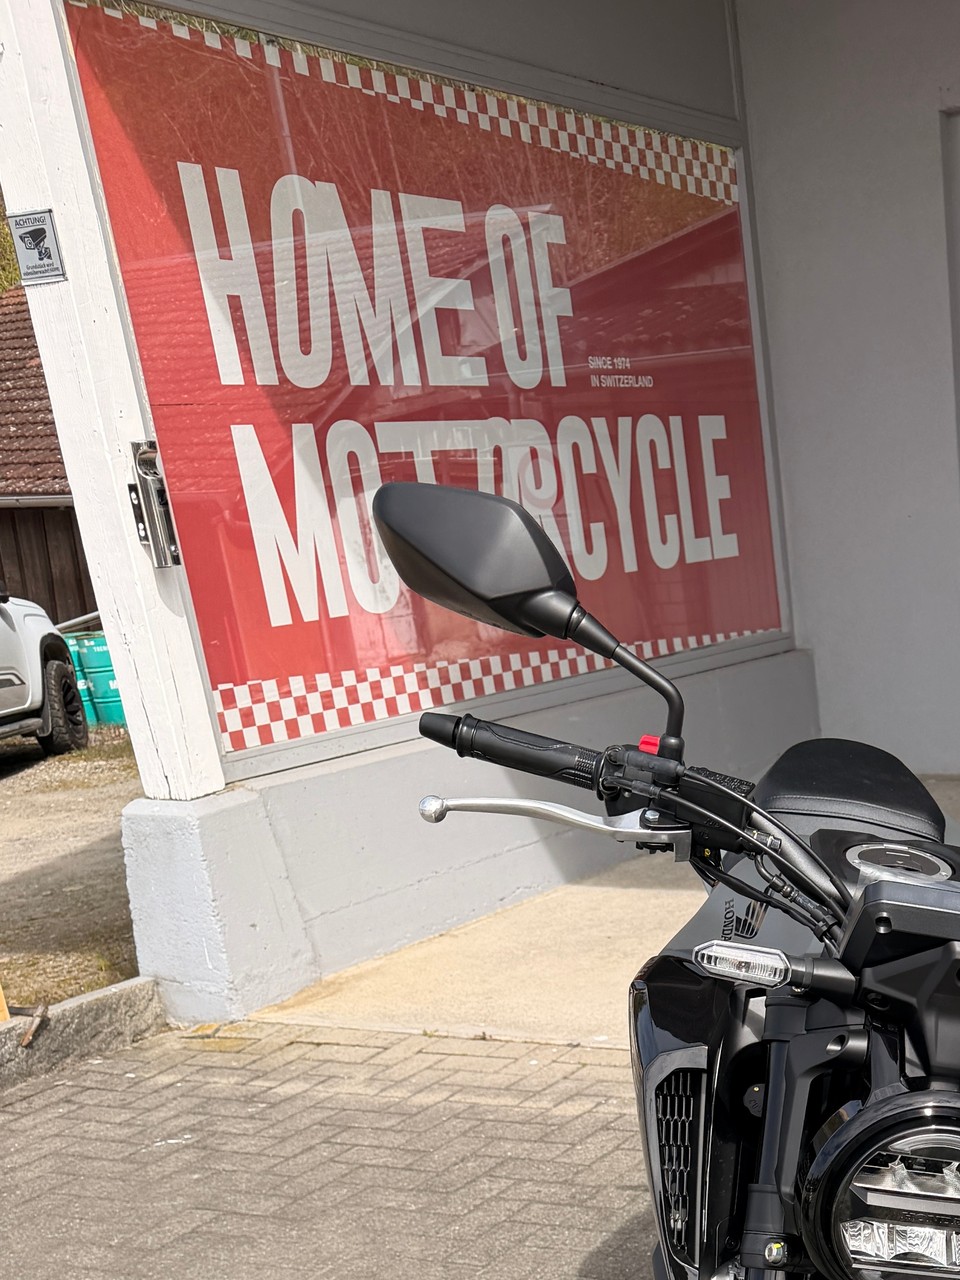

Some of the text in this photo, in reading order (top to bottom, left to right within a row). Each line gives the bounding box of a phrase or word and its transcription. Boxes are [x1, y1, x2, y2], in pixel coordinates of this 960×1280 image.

[15, 216, 46, 227] ACHTUNG!
[177, 162, 573, 390] HOME OF
[588, 356, 630, 369] SINCE 1974
[591, 374, 653, 387] IN SWITZERLAND
